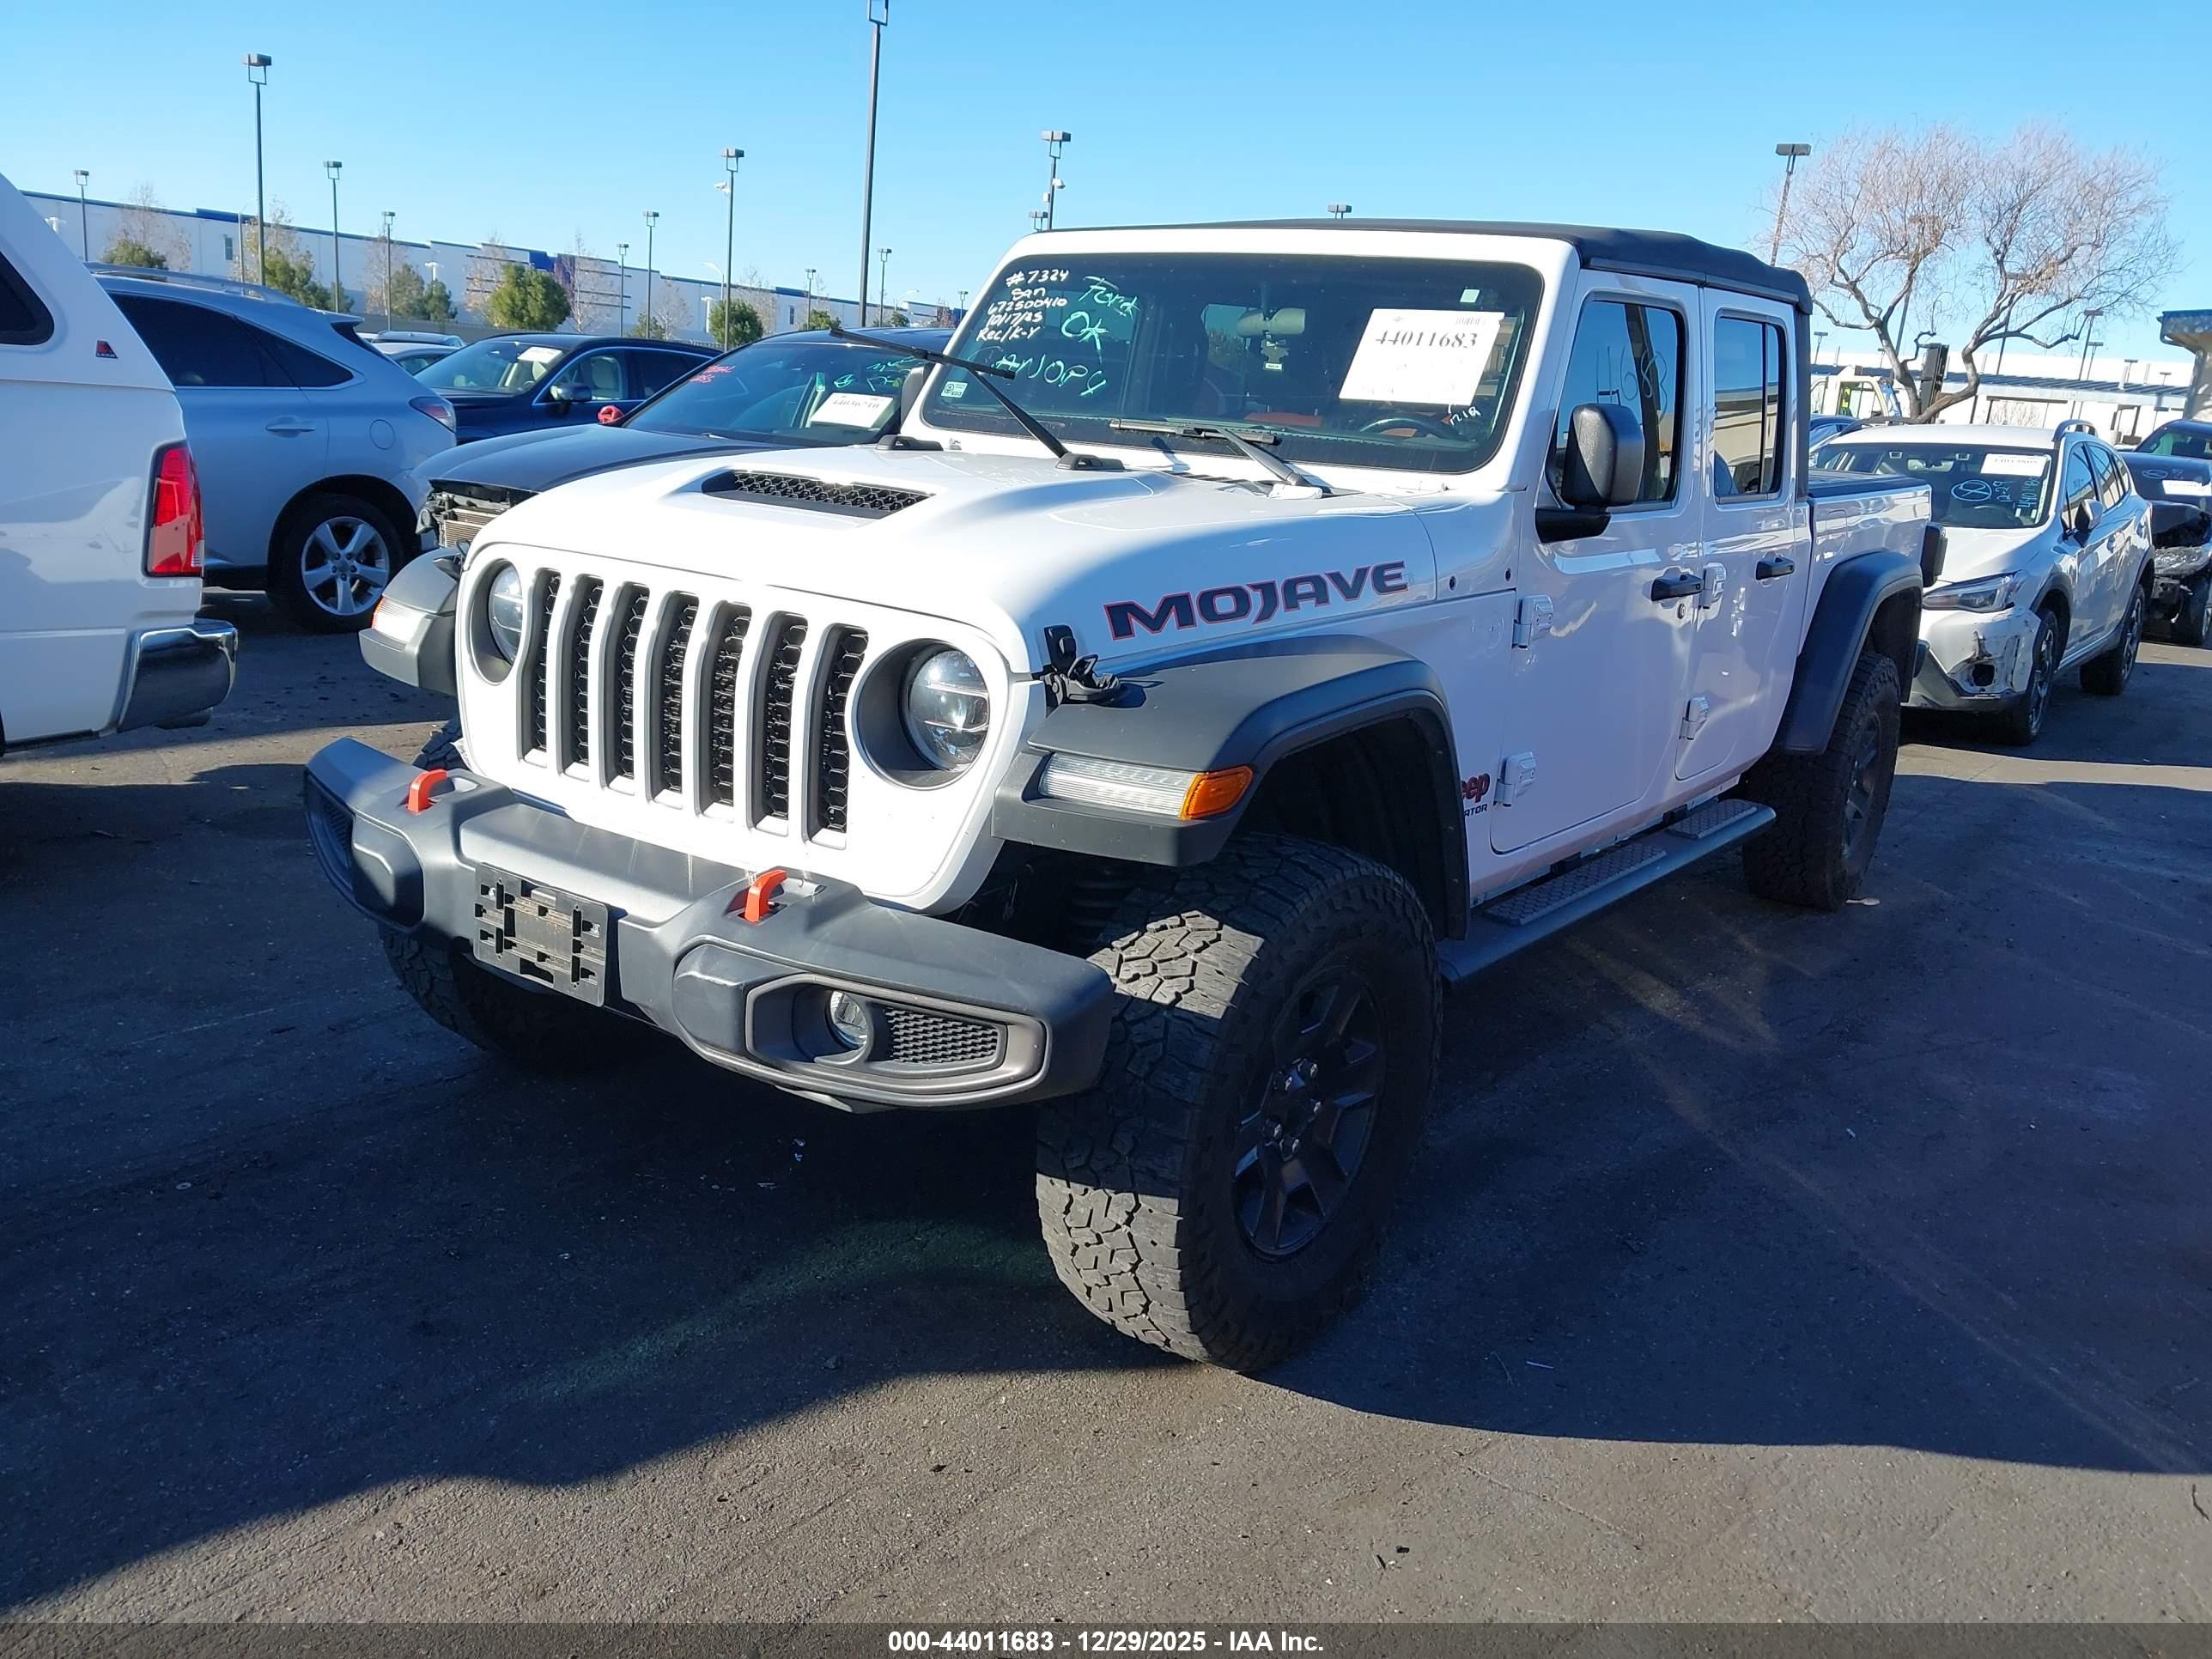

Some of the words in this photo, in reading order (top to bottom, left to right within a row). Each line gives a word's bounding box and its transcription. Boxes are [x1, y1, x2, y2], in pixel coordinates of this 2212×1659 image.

[1376, 331, 1478, 349] 44011683
[1103, 560, 1409, 641] MOJAVE
[1462, 772, 1491, 804] eep
[1463, 803, 1488, 817] ATOR
